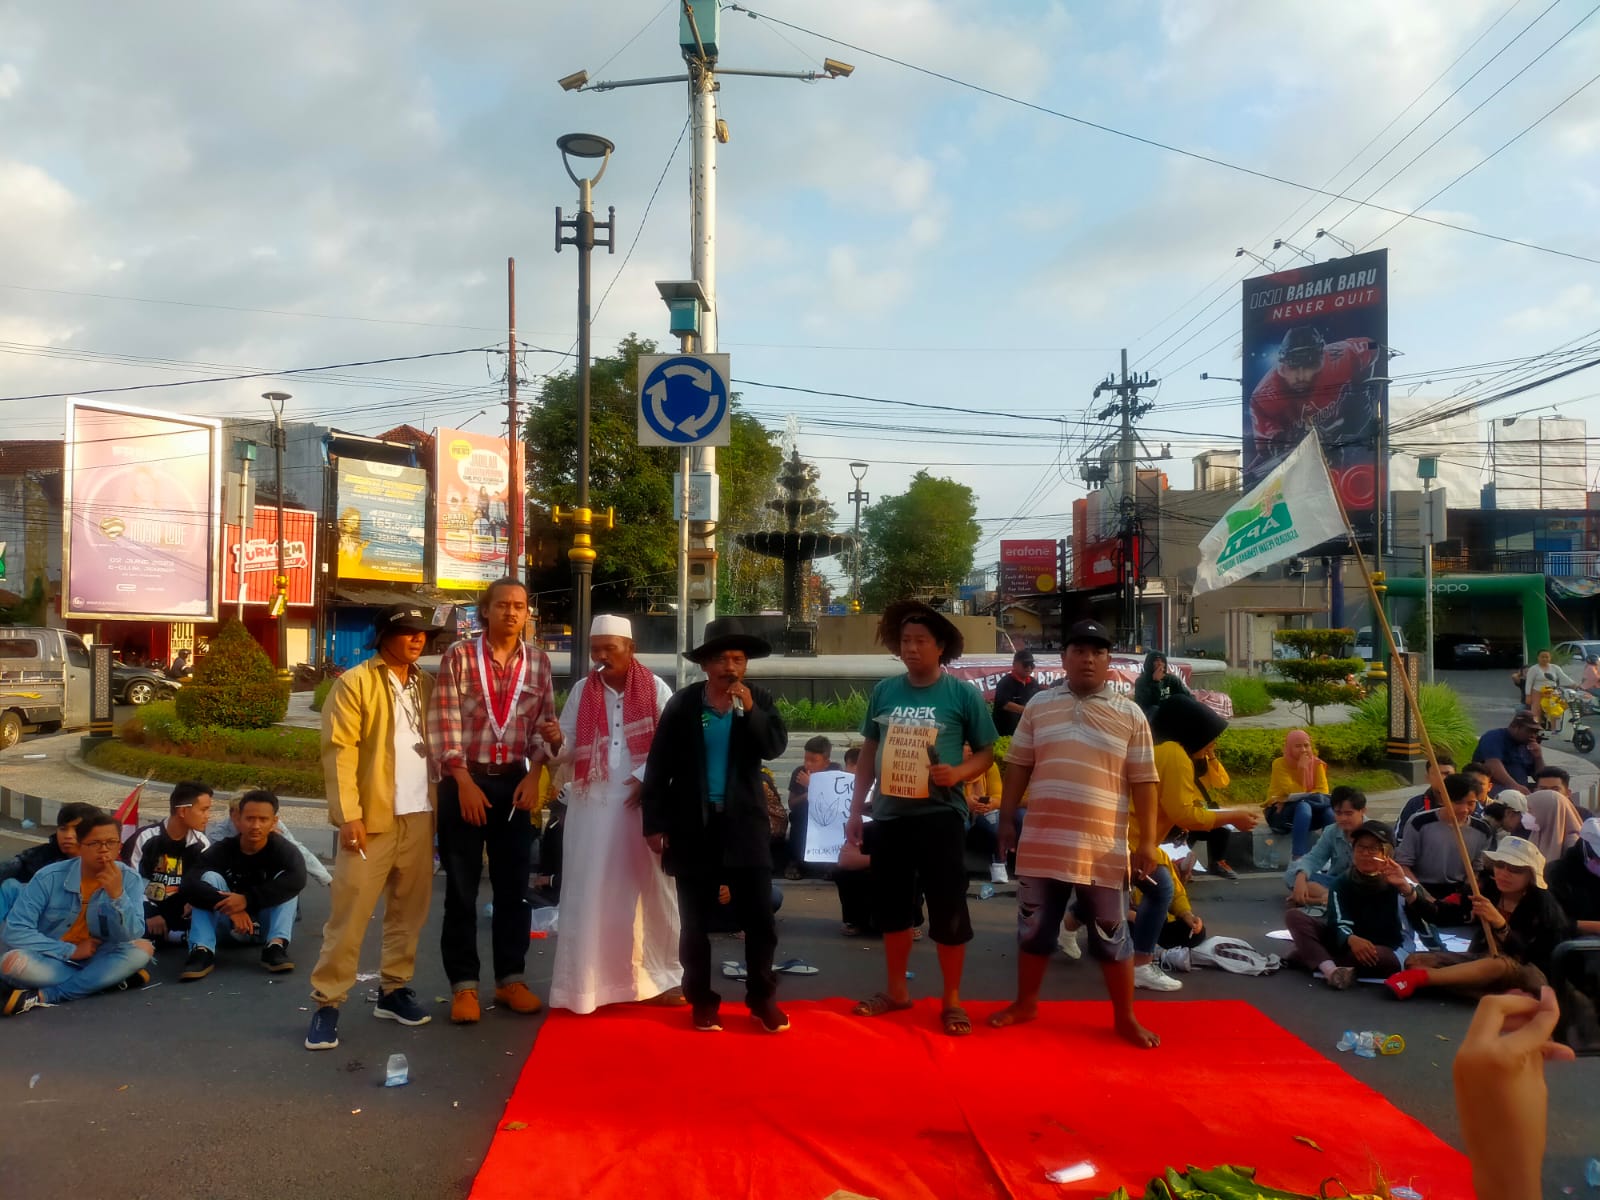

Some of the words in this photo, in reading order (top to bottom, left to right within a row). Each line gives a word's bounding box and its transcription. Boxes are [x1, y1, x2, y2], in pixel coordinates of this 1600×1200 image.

[1249, 288, 1283, 310] INI
[1286, 277, 1333, 301] BABAK
[1337, 268, 1377, 292] BARU
[1272, 300, 1325, 320] NEVER
[1334, 290, 1375, 307] QUIT
[1005, 545, 1050, 557] erafone
[171, 622, 193, 639] FULL
[890, 706, 936, 719] AREK
[892, 773, 917, 784] RAKYAT
